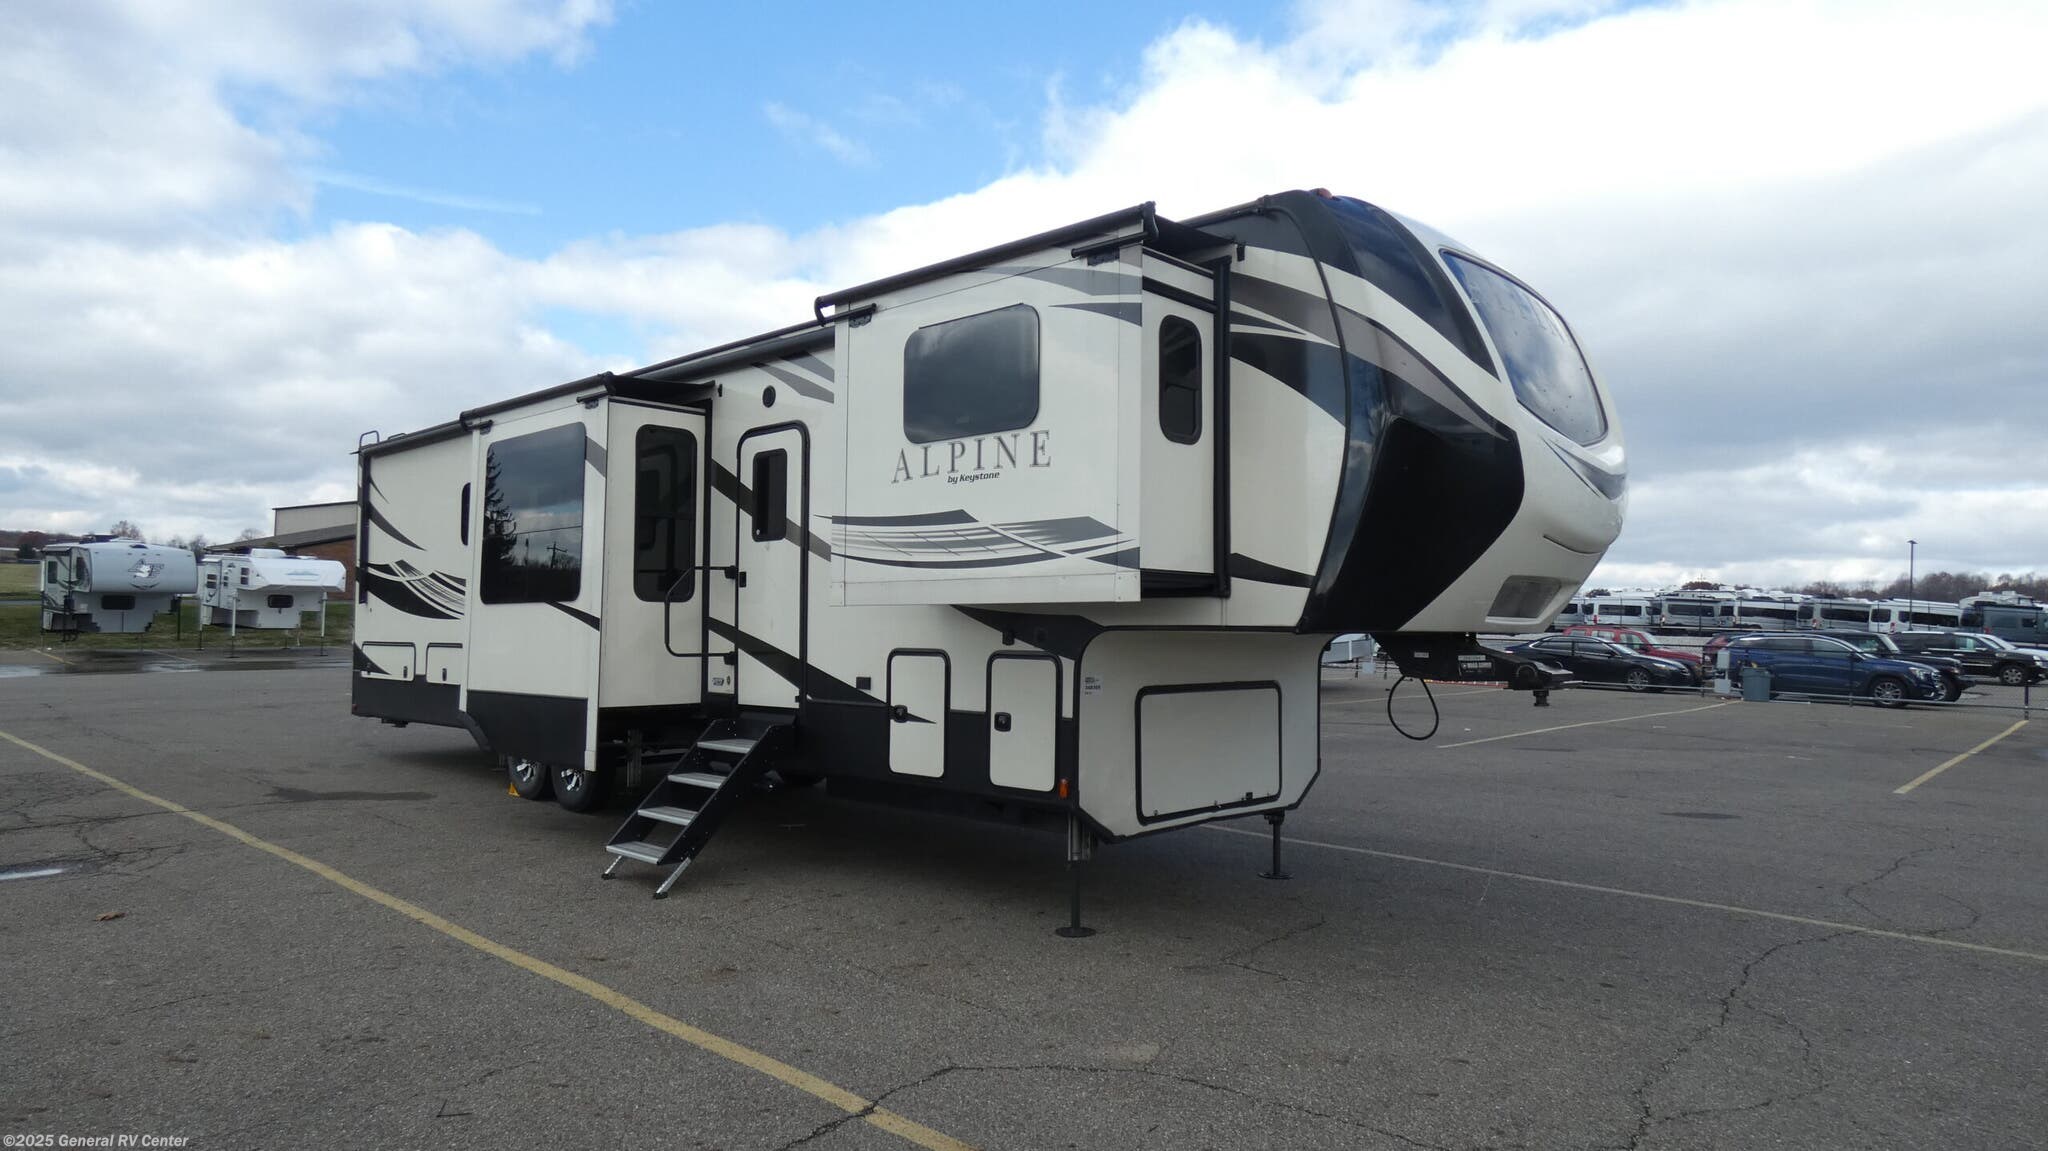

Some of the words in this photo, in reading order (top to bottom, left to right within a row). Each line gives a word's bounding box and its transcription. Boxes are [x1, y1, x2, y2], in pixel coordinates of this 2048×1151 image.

[891, 430, 1051, 483] ALPINE
[947, 475, 958, 484] by
[959, 471, 1000, 483] Keystone
